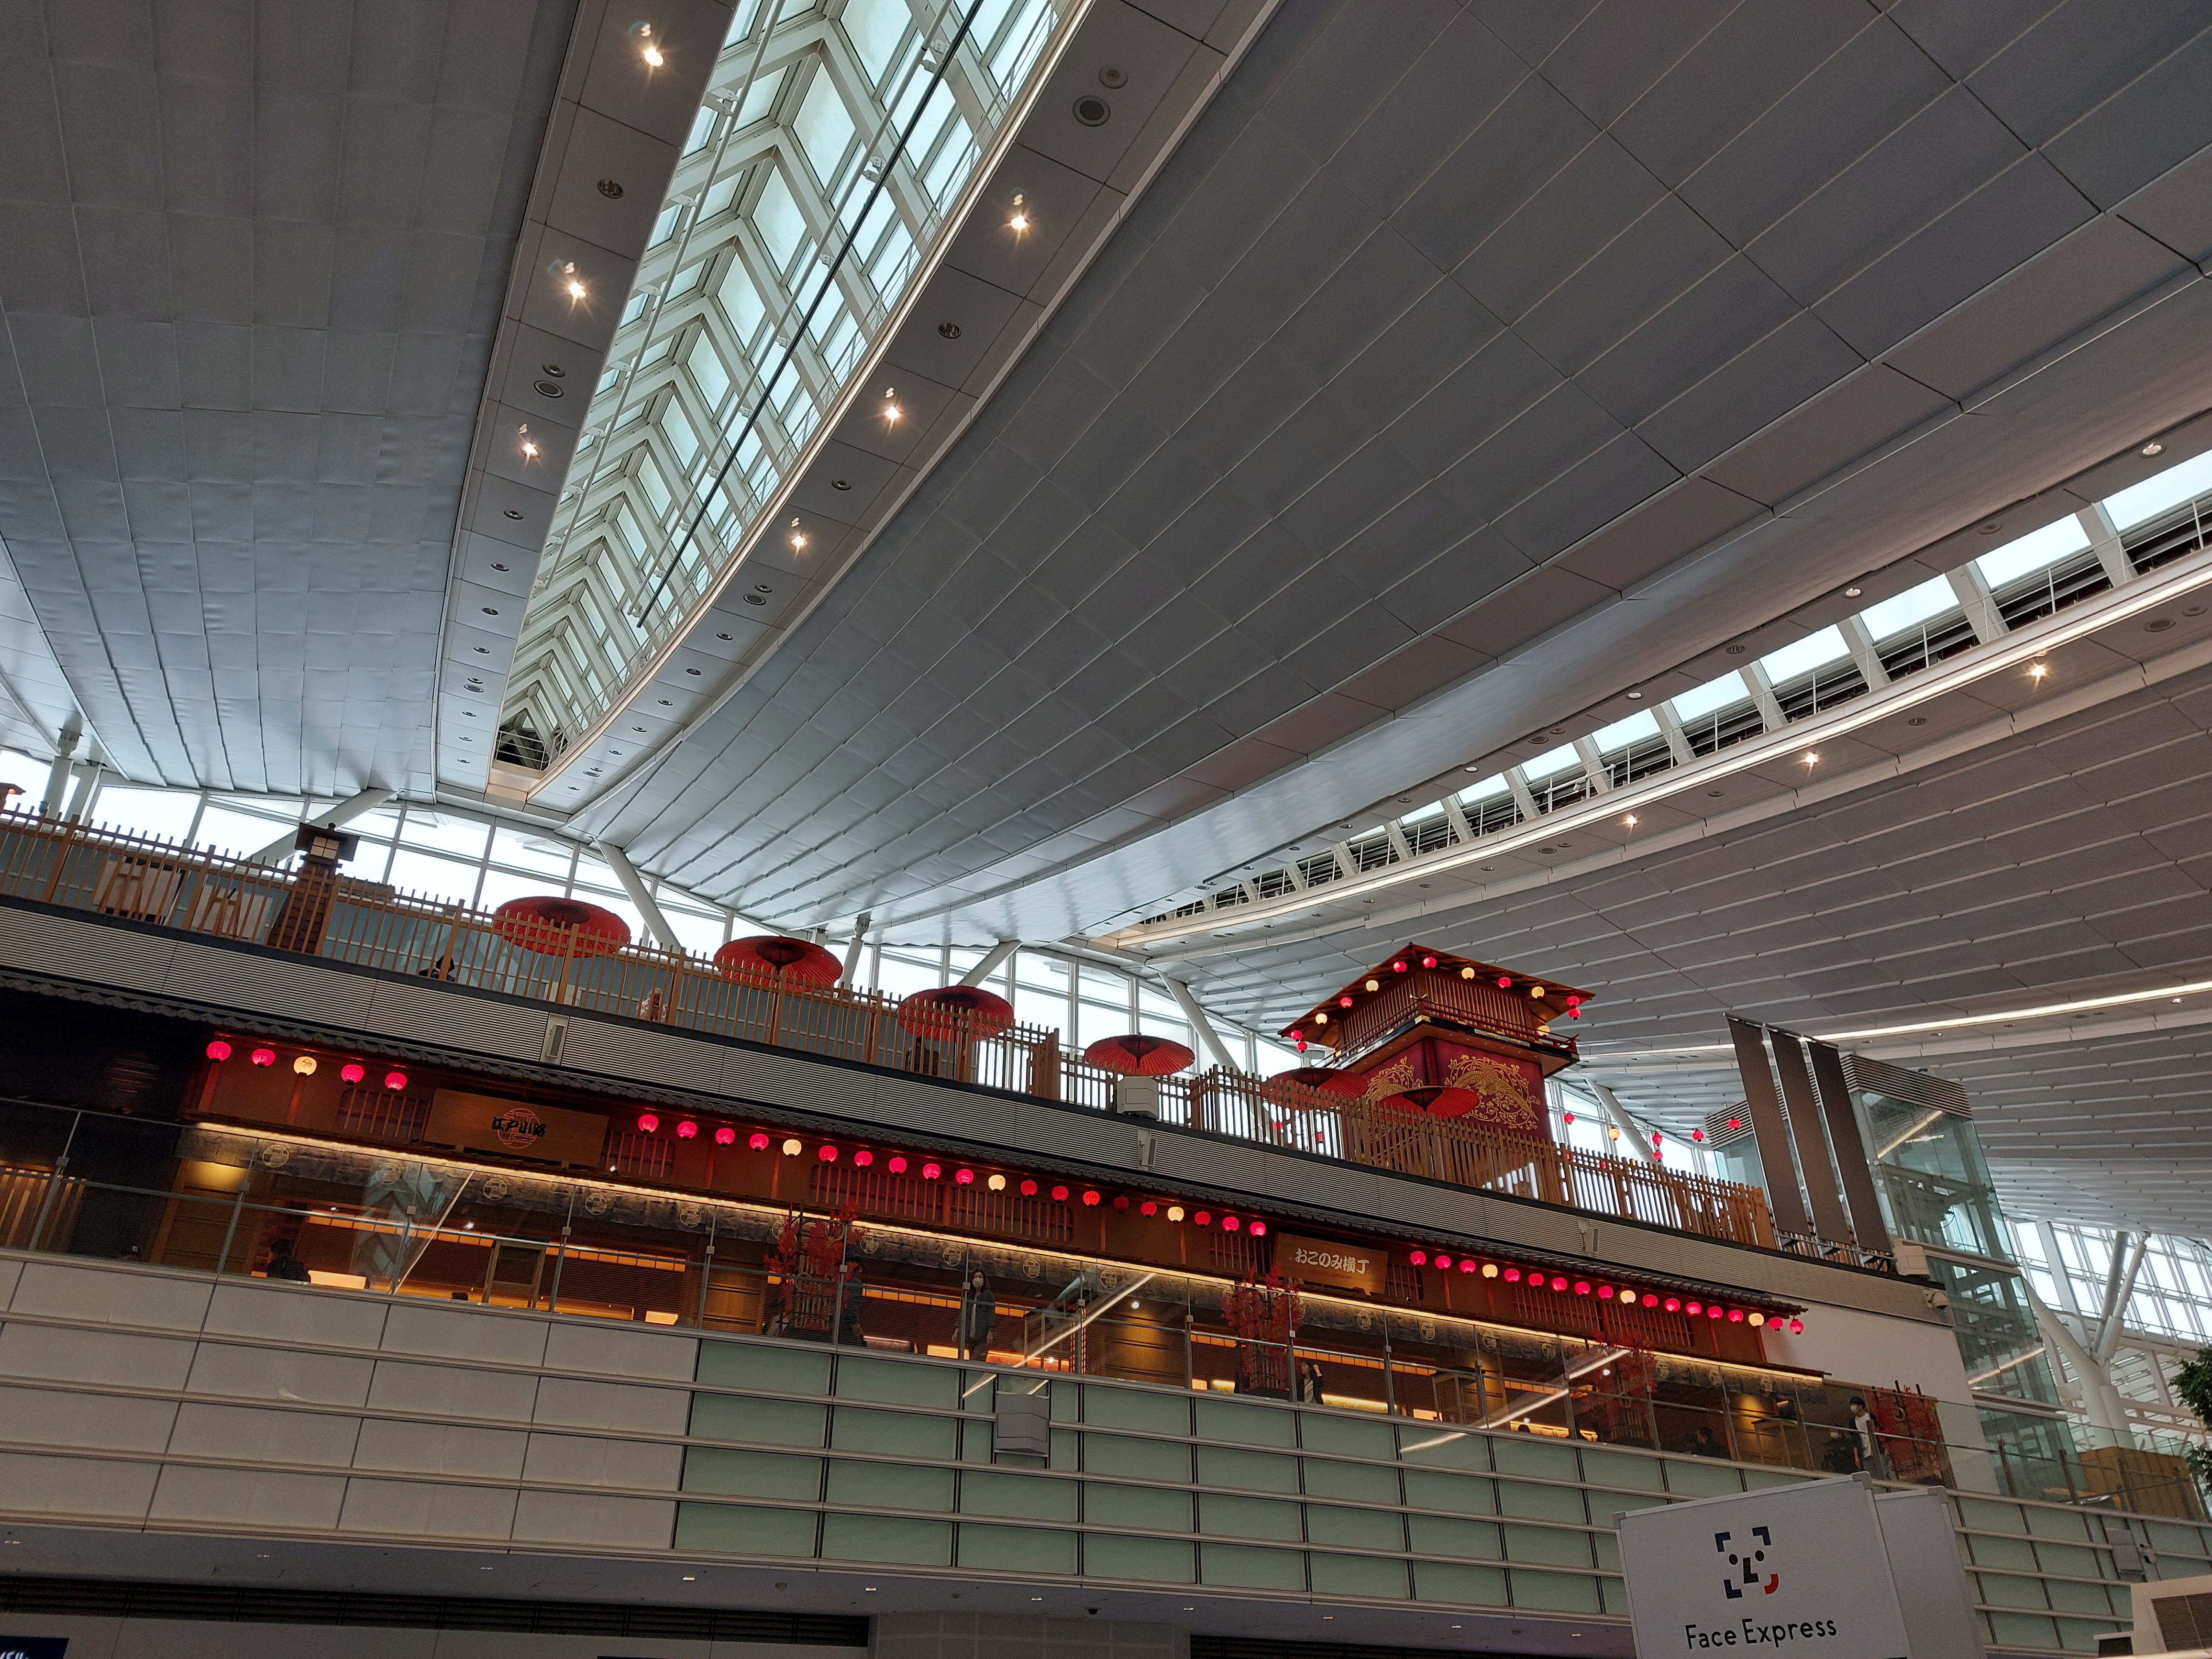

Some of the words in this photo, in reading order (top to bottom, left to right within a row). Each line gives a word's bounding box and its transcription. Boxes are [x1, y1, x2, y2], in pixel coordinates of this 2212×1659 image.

[491, 1116, 546, 1138] 江戸小路
[1294, 1247, 1370, 1275] おこのみ横丁
[1685, 1624, 1737, 1649] Face
[1741, 1618, 1837, 1648] Express
